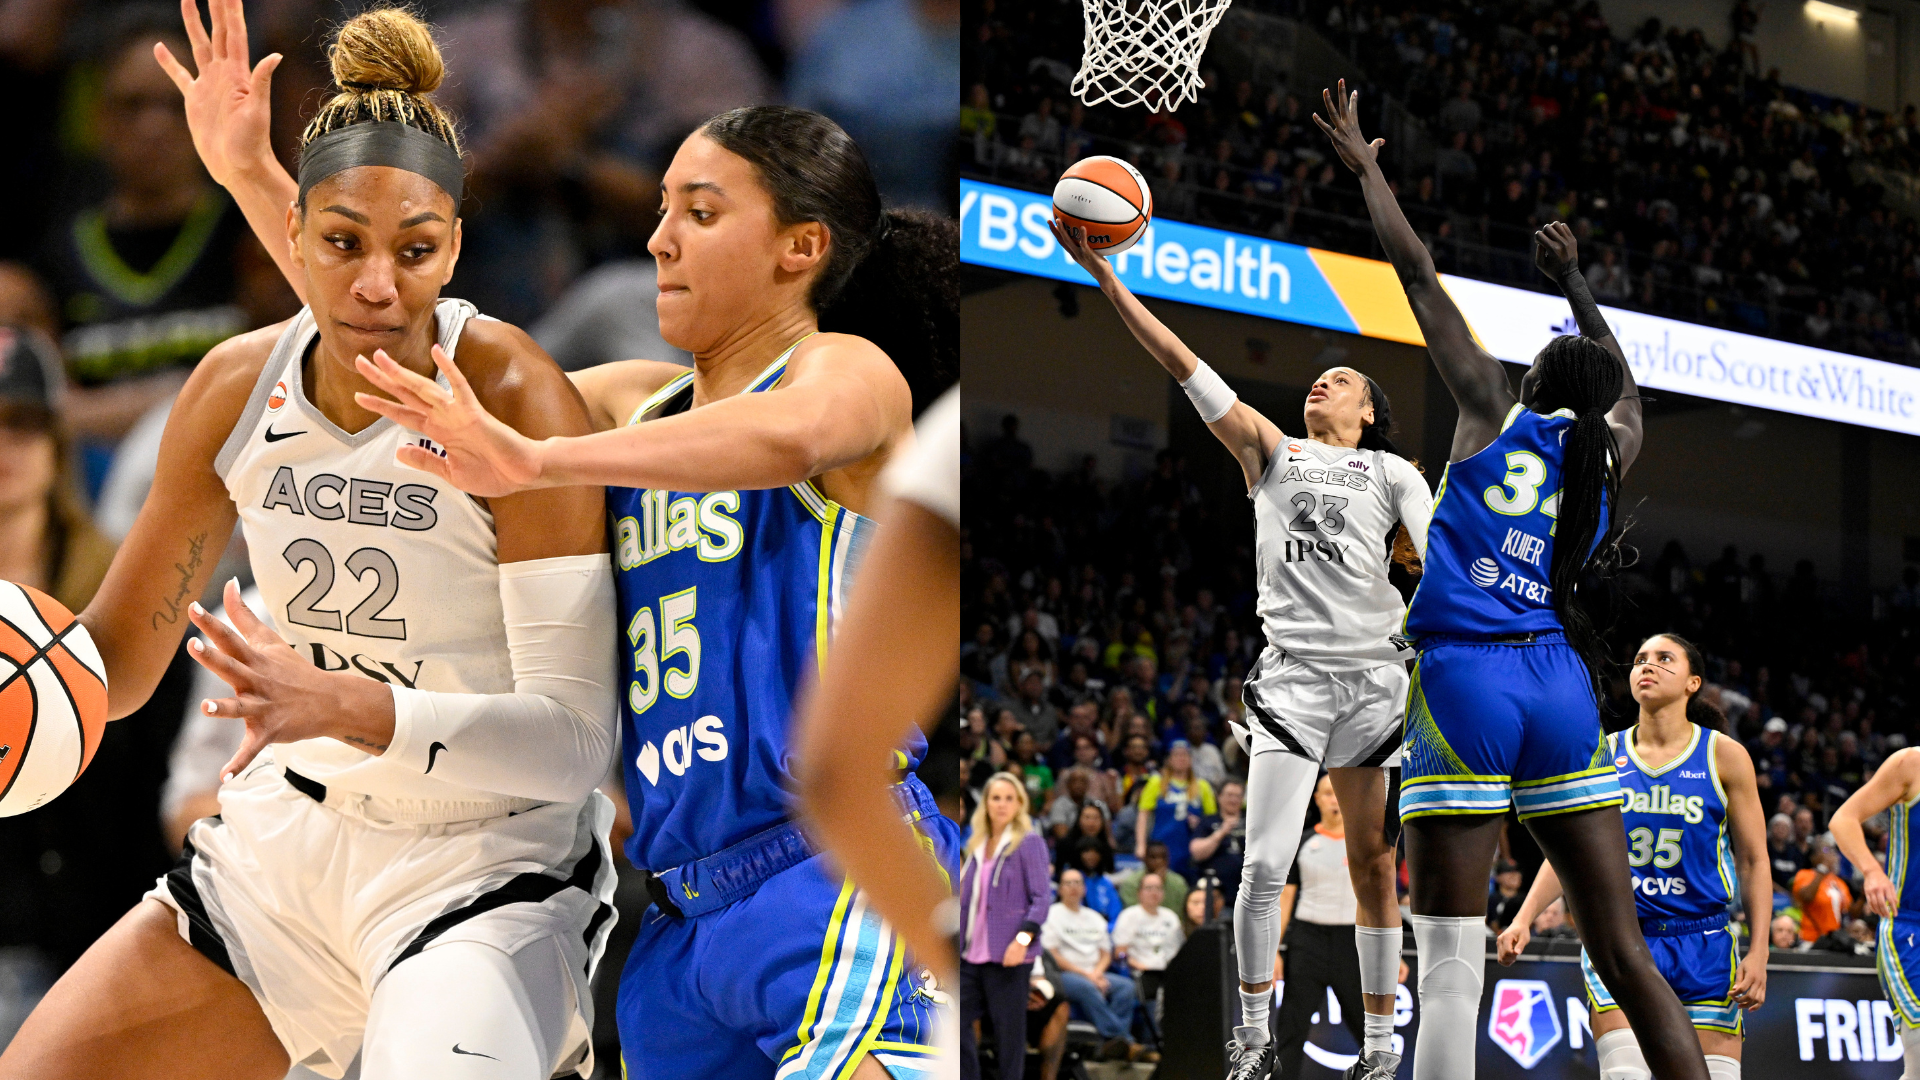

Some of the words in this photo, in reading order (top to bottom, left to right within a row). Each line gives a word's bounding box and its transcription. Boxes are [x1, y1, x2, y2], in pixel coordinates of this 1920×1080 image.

[1055, 213, 1112, 244] ilon
[1279, 465, 1370, 491] ACES
[1347, 460, 1370, 472] ally
[262, 465, 439, 532] ACES
[1288, 491, 1349, 535] 23
[612, 489, 744, 563] allas
[1284, 540, 1350, 563] IPSY
[1501, 527, 1546, 567] KUIER
[282, 538, 407, 641] 22
[1499, 572, 1553, 604] AT&T
[289, 642, 424, 690] PSY
[627, 585, 701, 715] 35
[662, 714, 729, 777] CVS
[1678, 769, 1707, 779] Albert
[1620, 784, 1704, 824] Dallas
[1628, 826, 1684, 869] 35
[1641, 876, 1687, 896] CVS
